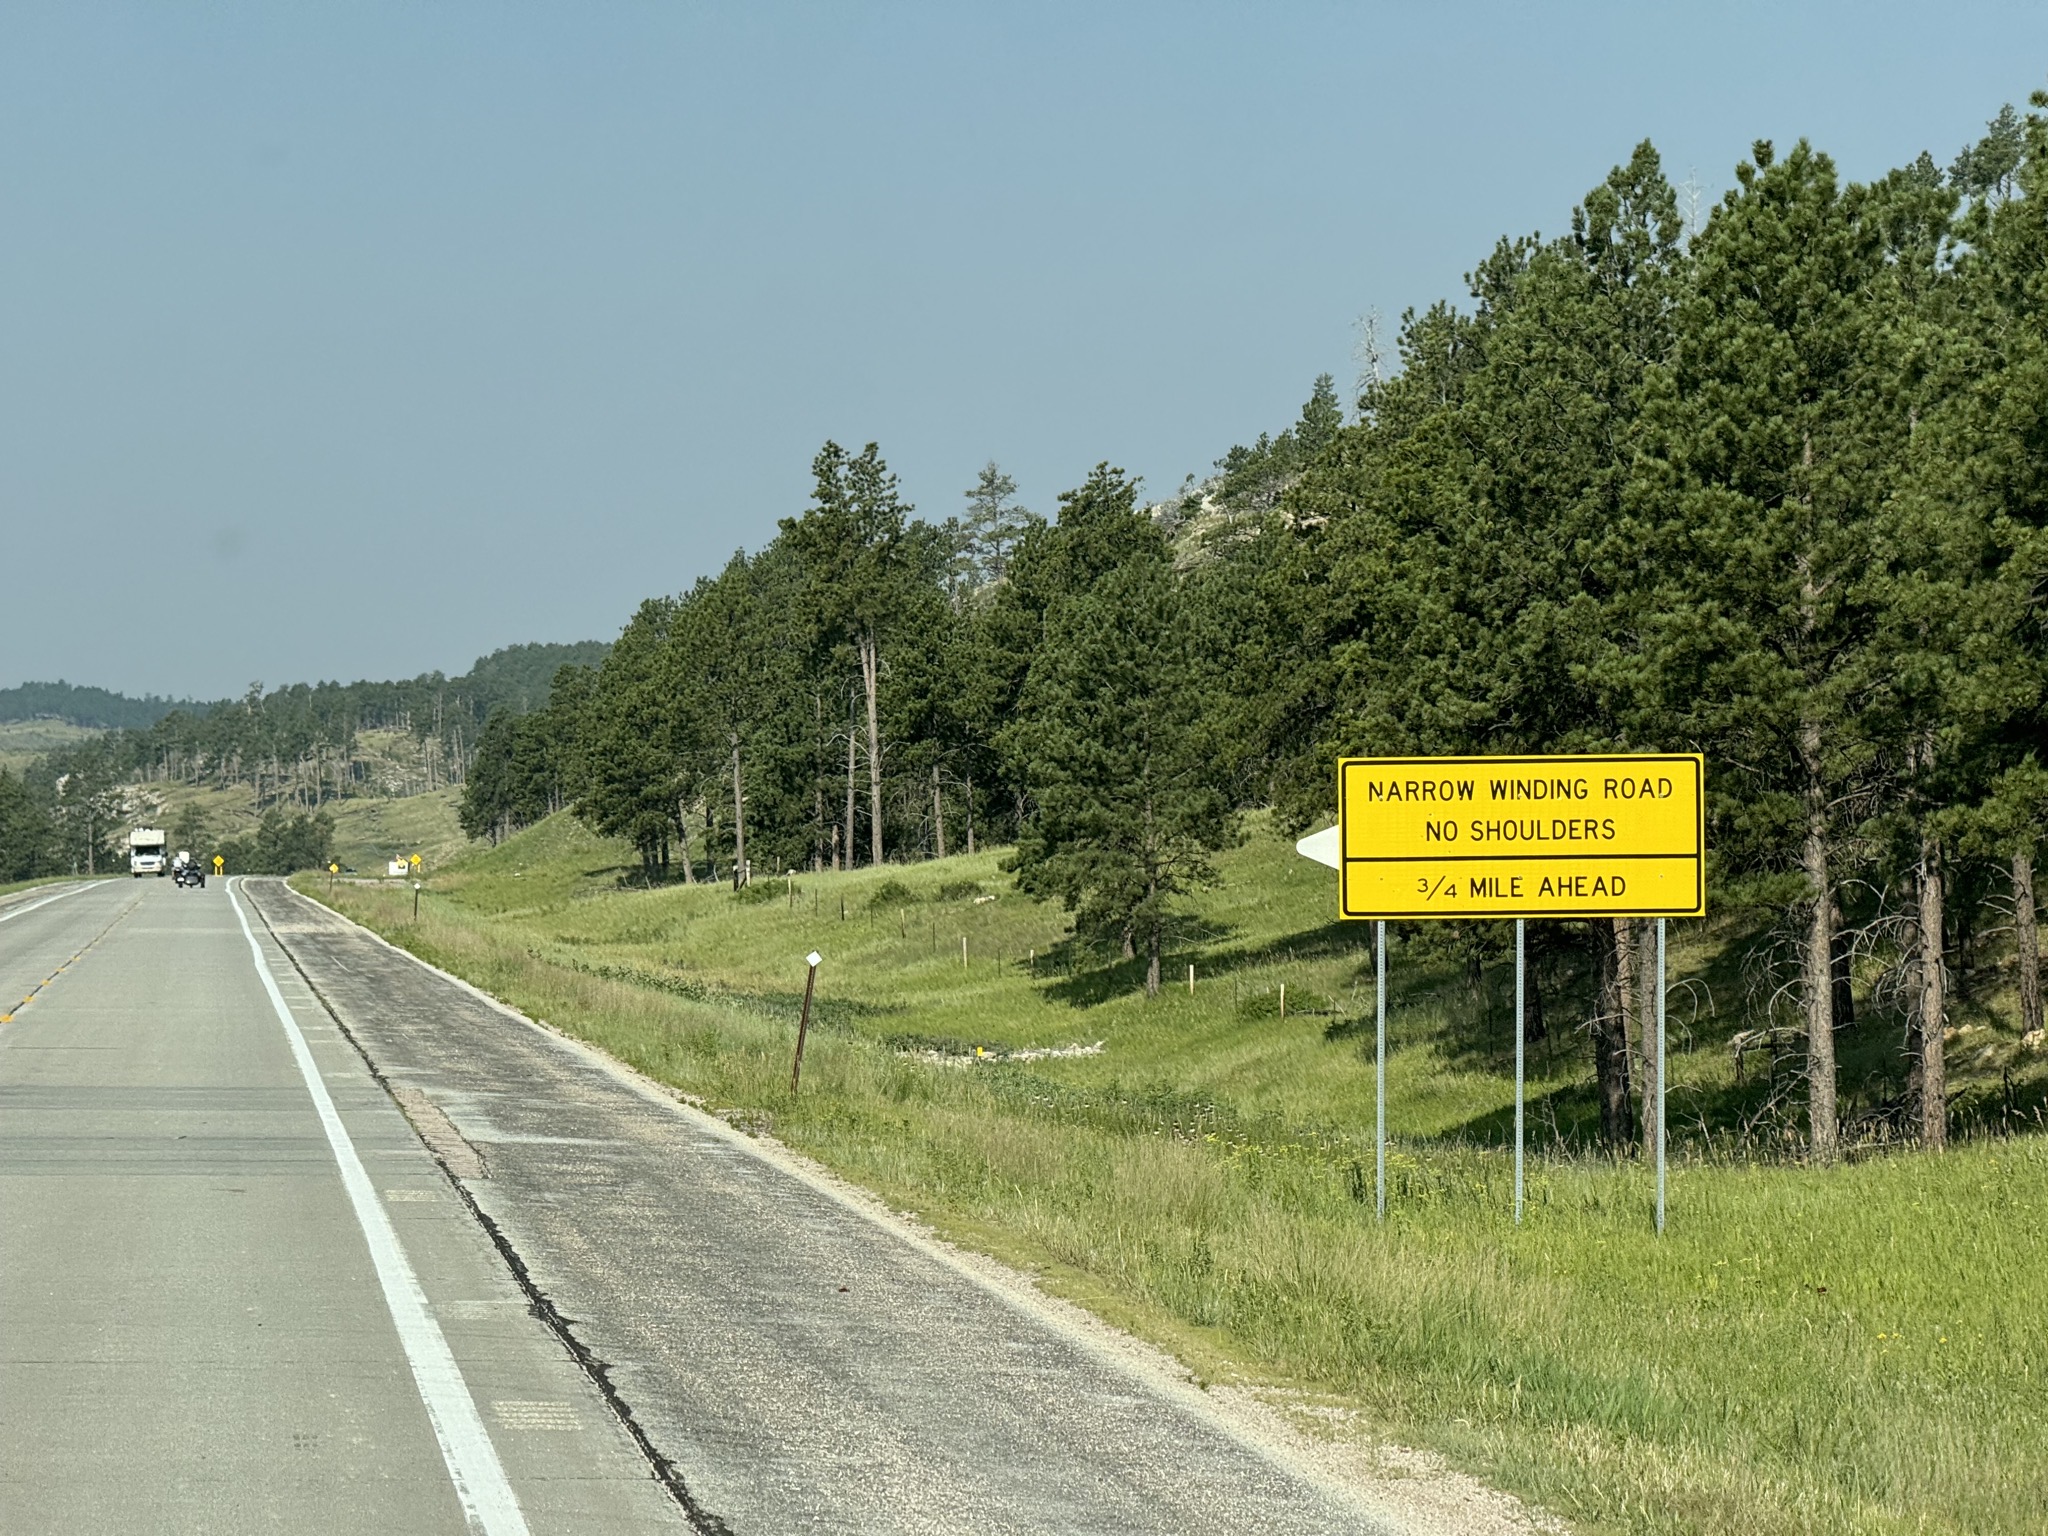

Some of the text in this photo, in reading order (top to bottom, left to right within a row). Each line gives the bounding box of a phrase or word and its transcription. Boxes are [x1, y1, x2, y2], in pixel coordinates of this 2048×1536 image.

[1368, 777, 1673, 802] NARROW WINDING ROAD
[1426, 818, 1616, 842] NO SHOULDERS
[1470, 876, 1524, 898] MILE
[1538, 875, 1627, 897] AHEAD
